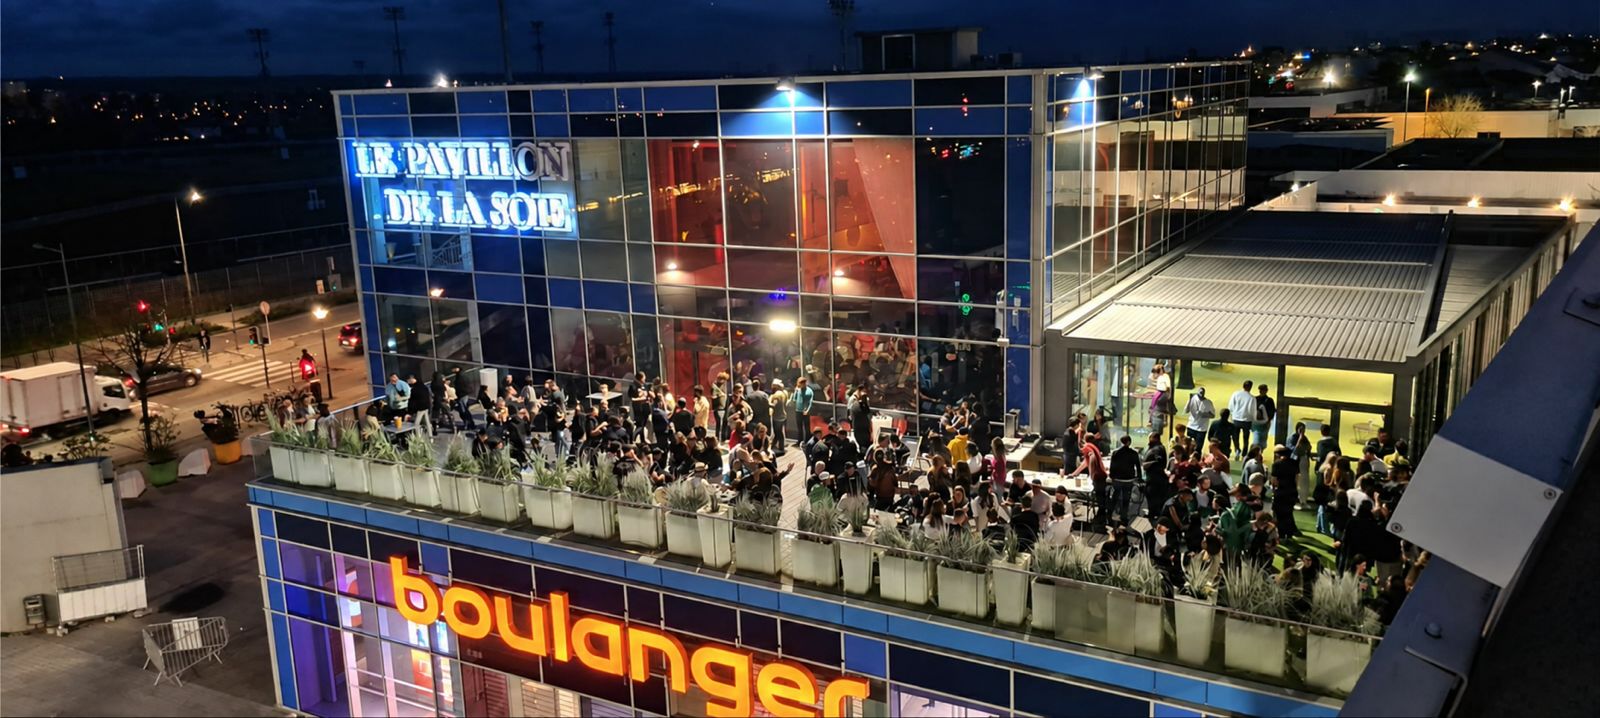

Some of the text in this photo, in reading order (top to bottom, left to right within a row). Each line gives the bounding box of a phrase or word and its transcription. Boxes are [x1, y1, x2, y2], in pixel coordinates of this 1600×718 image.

[352, 141, 570, 181] LE PAVILLON
[384, 188, 573, 232] DE LA SOIE
[389, 555, 870, 717] boulanger
